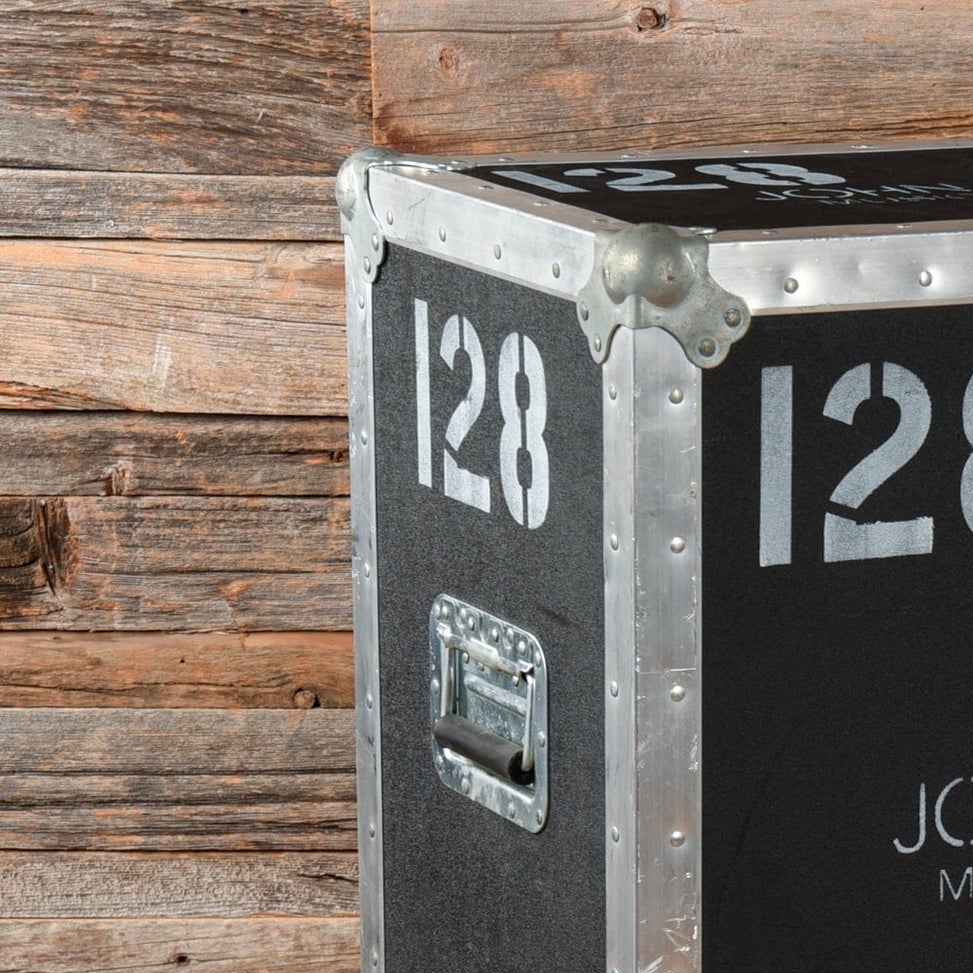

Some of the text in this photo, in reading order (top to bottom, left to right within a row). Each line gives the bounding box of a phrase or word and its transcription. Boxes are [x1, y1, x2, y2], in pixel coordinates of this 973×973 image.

[491, 162, 848, 194] 128
[756, 181, 972, 201] JOHN
[412, 298, 550, 530] 128
